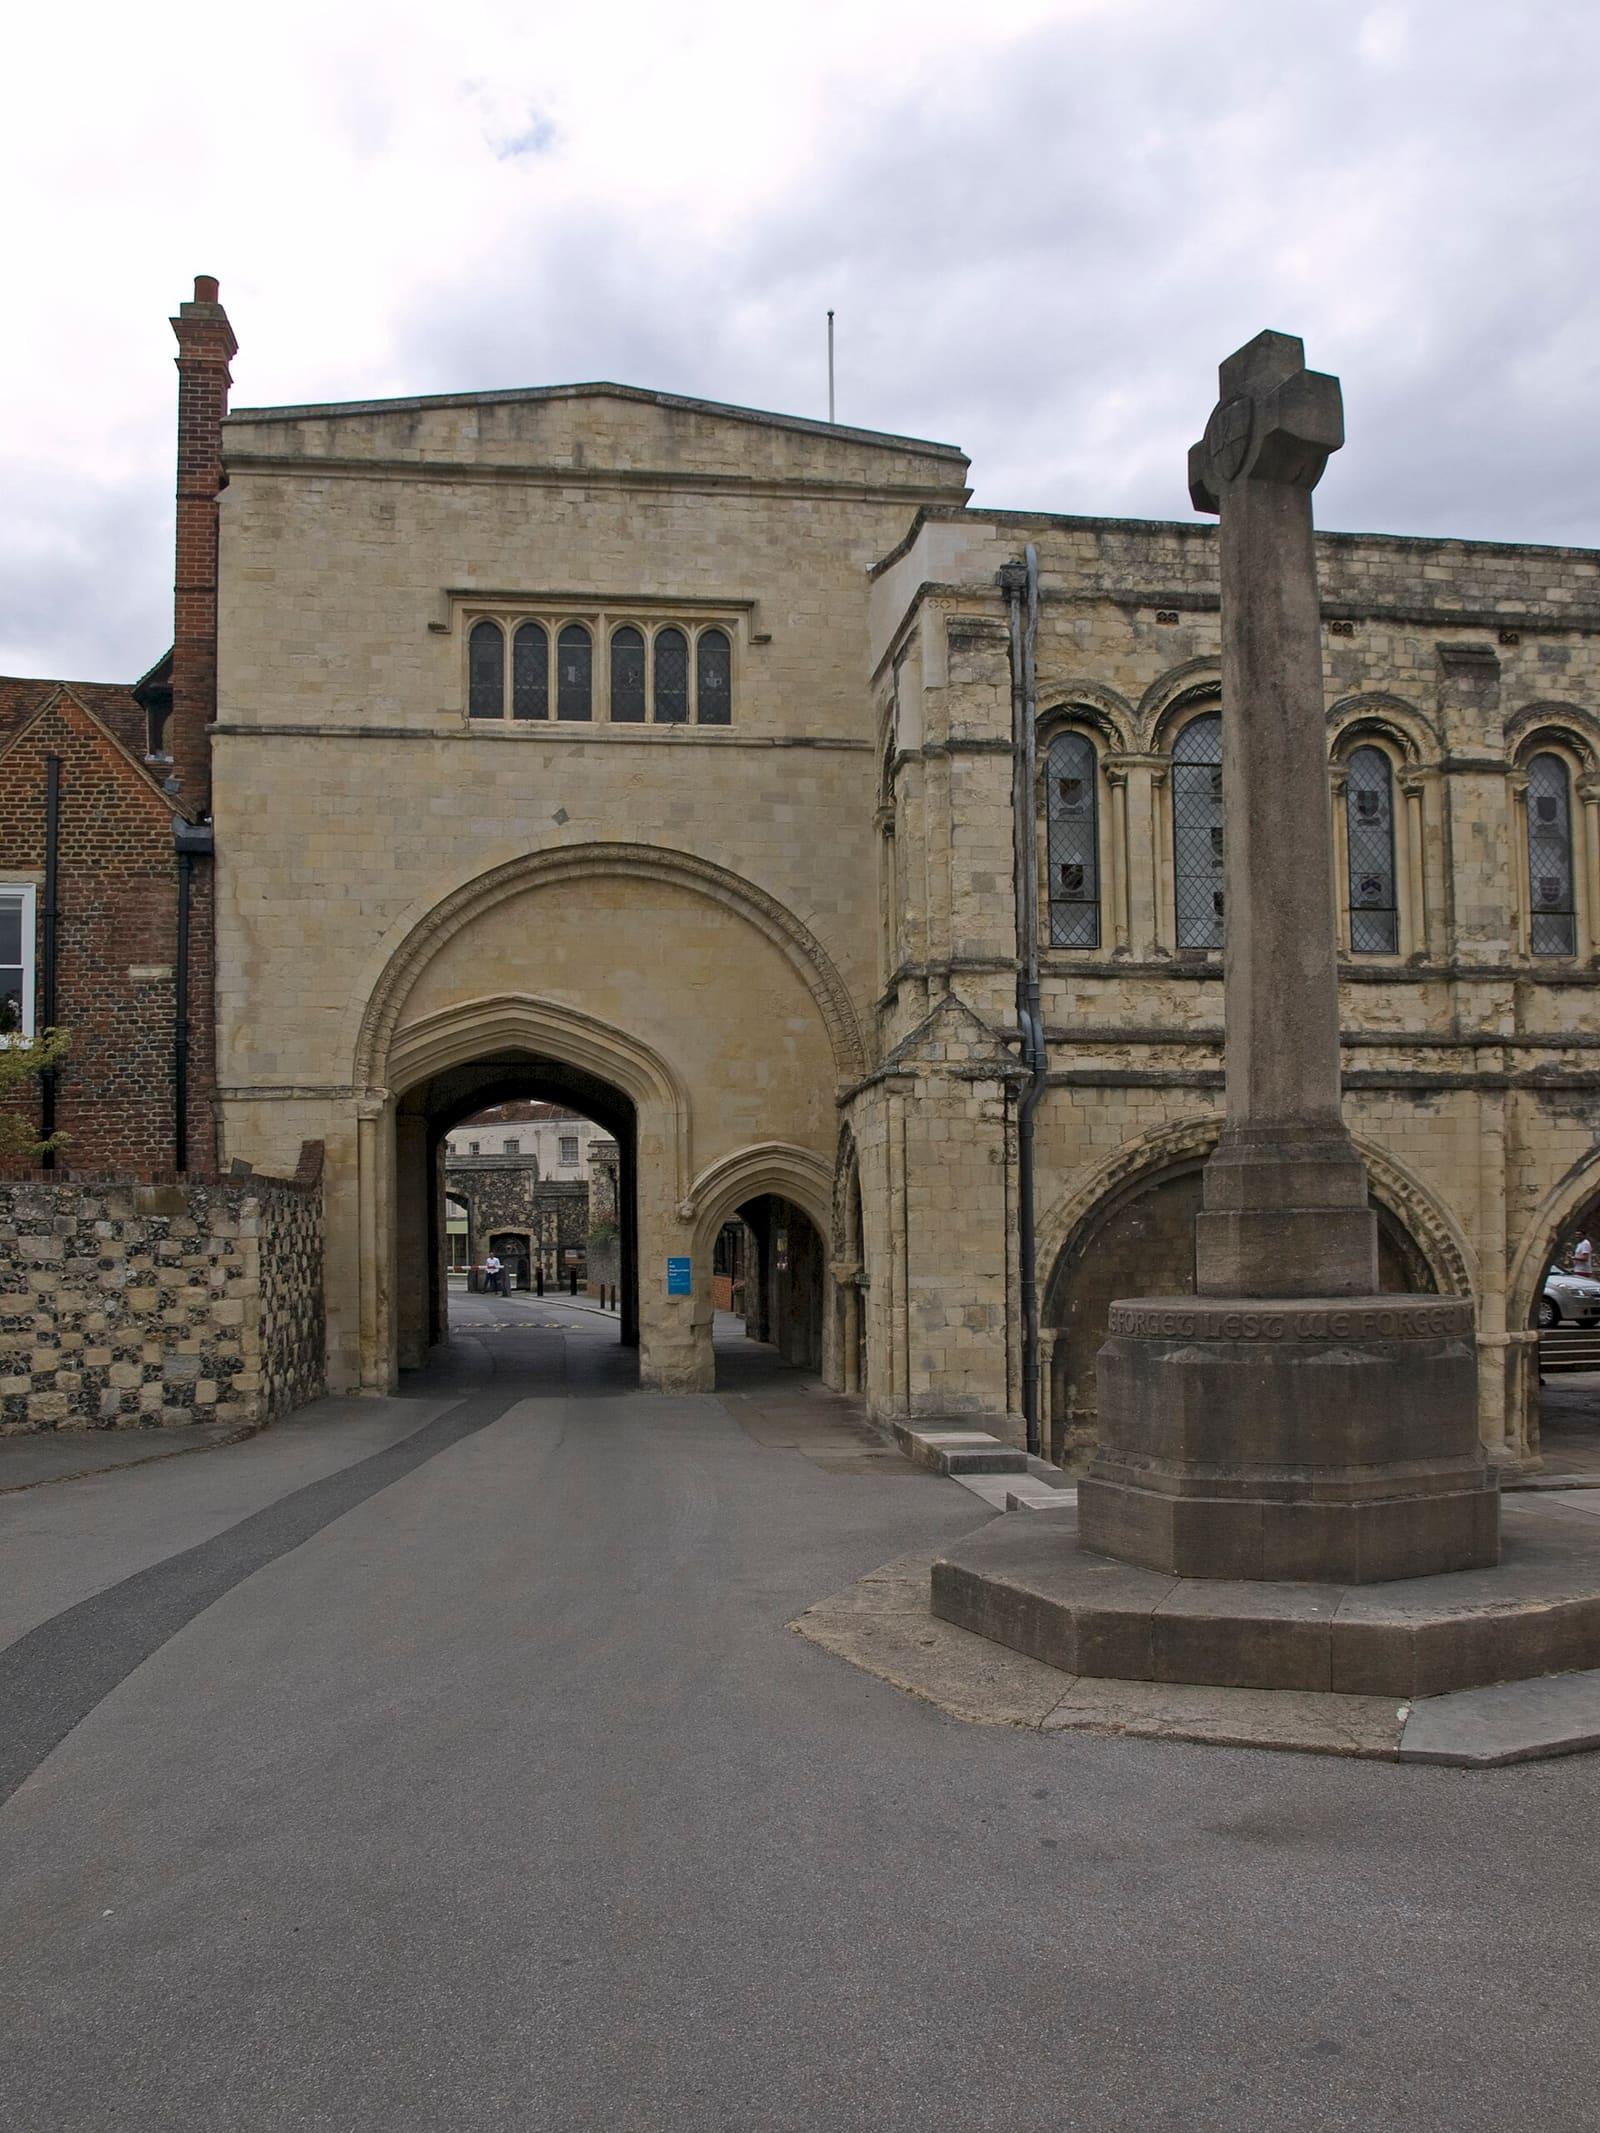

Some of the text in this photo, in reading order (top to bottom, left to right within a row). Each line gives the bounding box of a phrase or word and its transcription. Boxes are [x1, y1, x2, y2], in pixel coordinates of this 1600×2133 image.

[1118, 1310, 1196, 1336] FORGET
[1202, 1312, 1284, 1339] LEST
[1294, 1312, 1350, 1339] WE
[1359, 1307, 1457, 1338] FORGET
